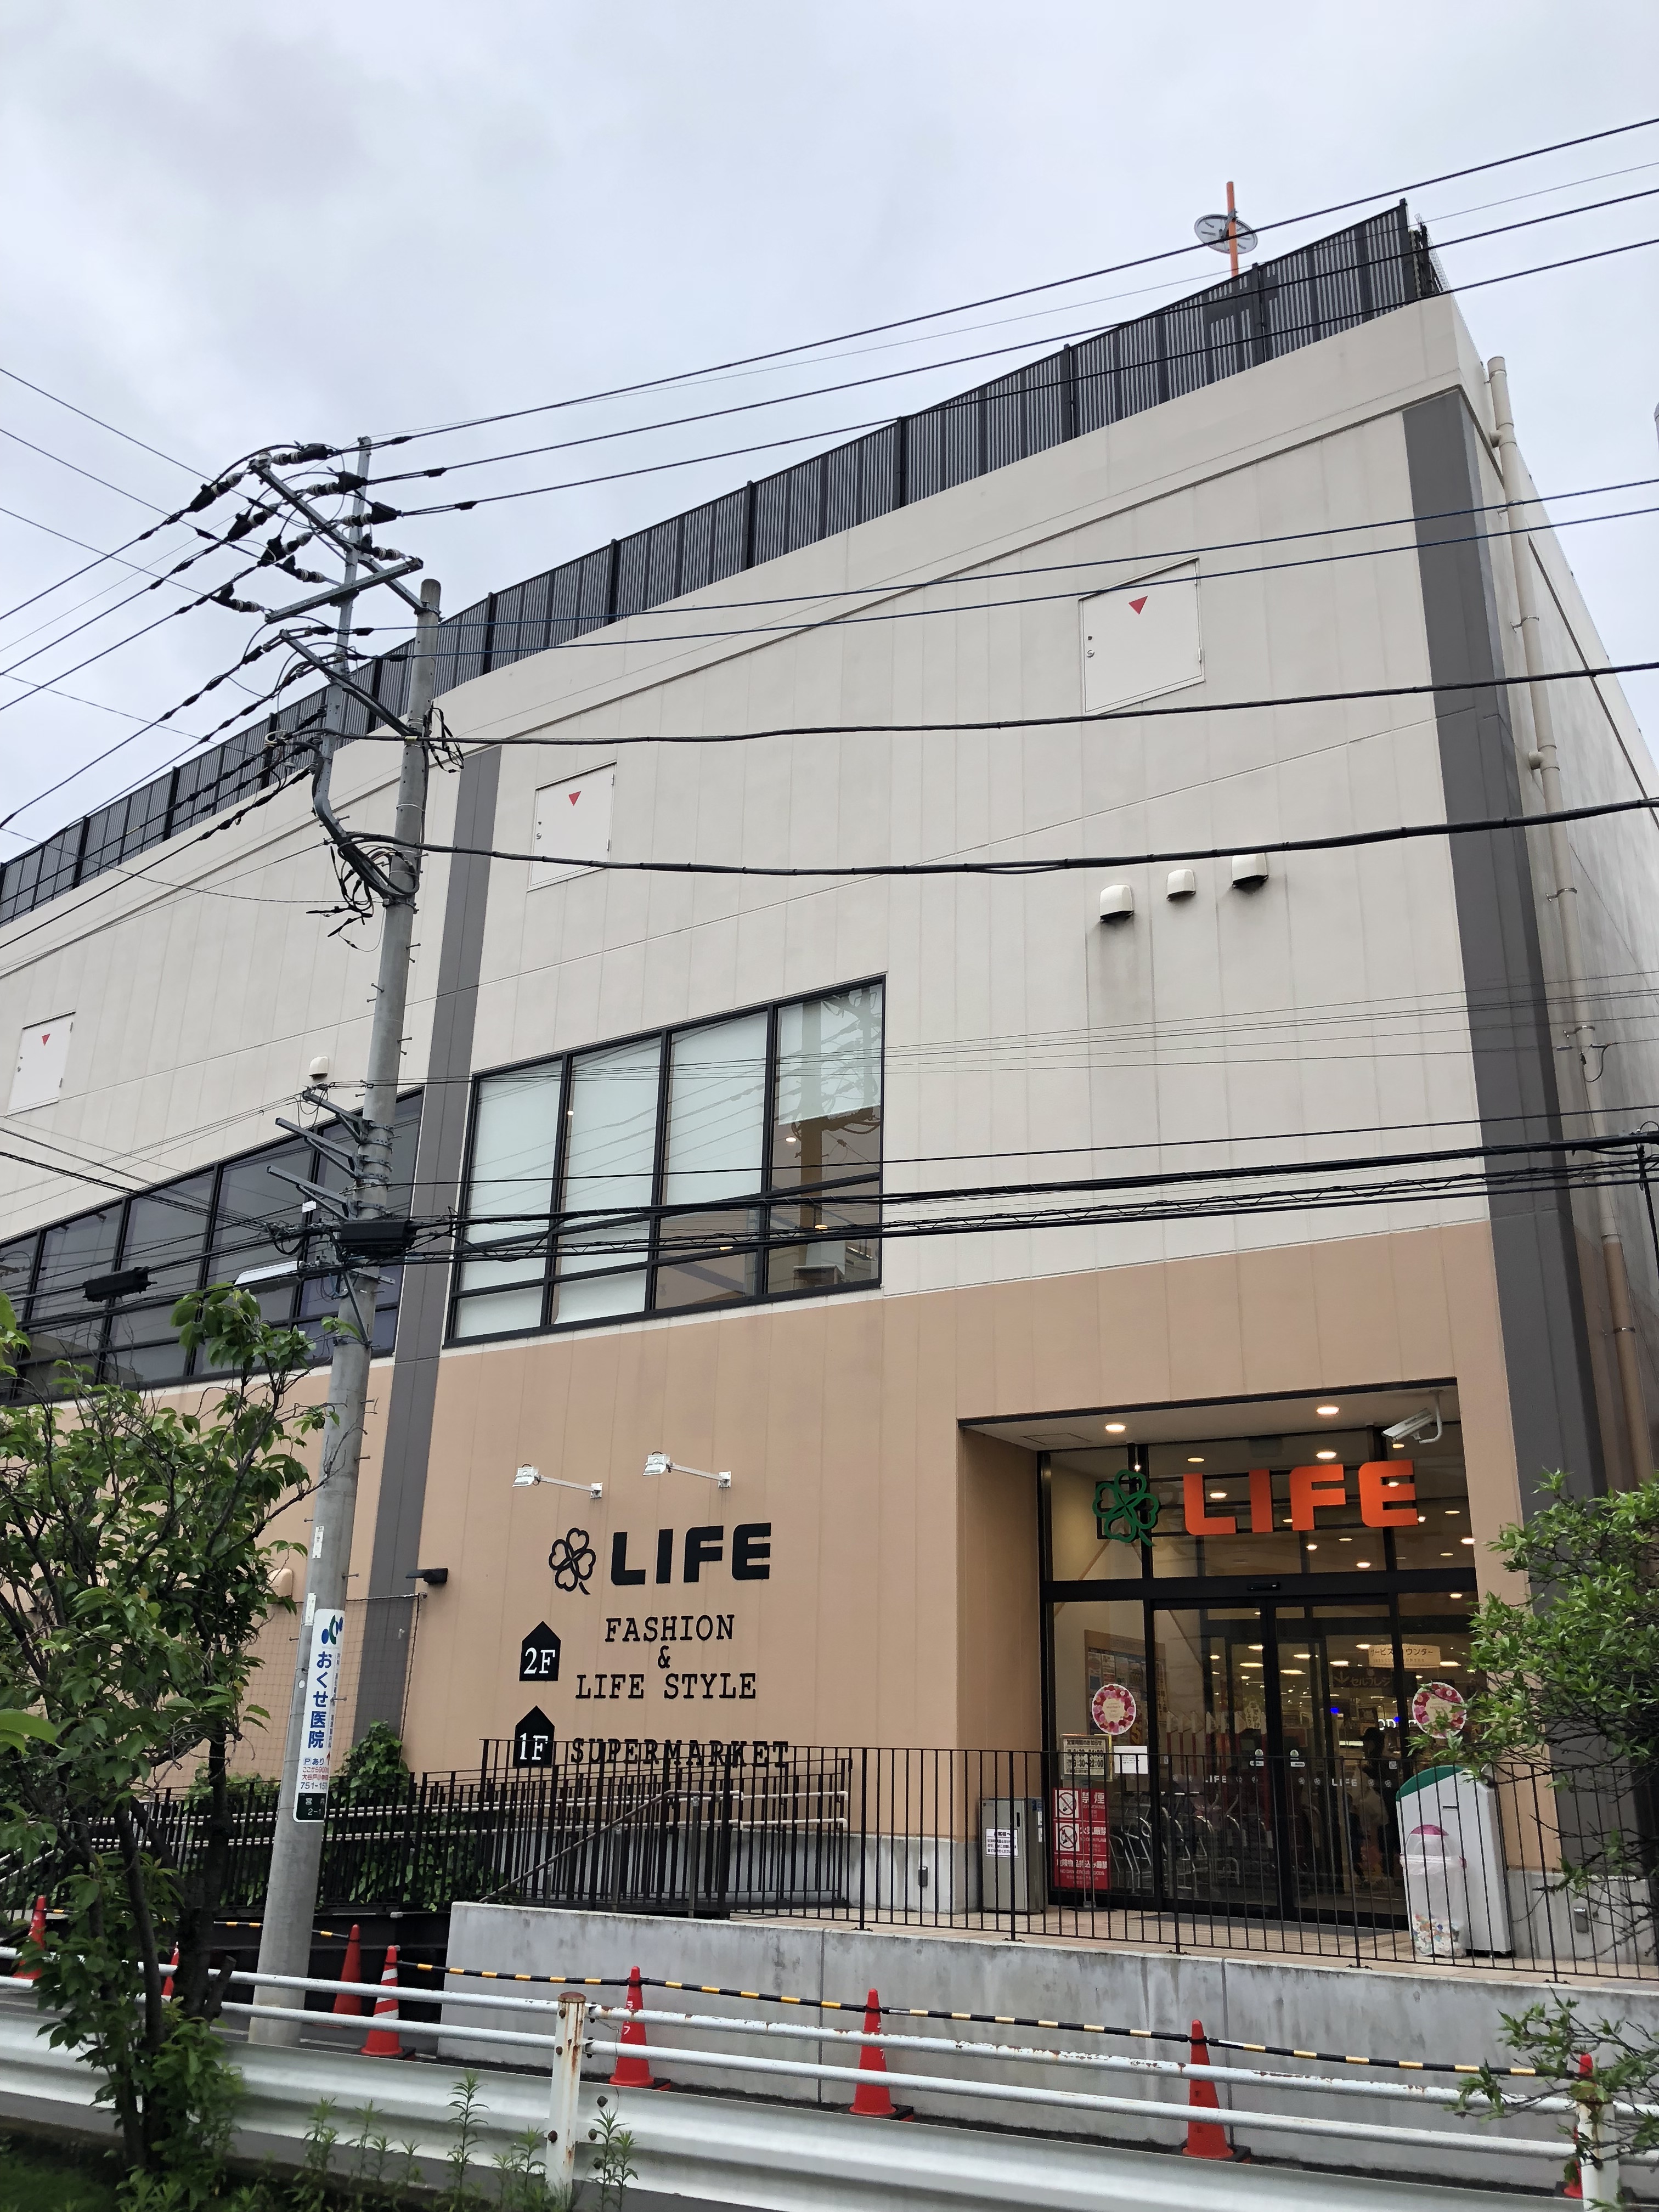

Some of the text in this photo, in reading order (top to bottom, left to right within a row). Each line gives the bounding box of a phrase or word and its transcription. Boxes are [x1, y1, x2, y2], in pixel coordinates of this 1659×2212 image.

[1183, 1459, 1419, 1536] LIFE
[611, 1522, 771, 1585] LIFE
[605, 1615, 735, 1642] FASHION
[524, 1647, 556, 1674] 2F
[658, 1645, 670, 1668] &
[308, 1651, 332, 1748] おくせ医院
[575, 1673, 756, 1700] LIFE STYLE
[519, 1735, 548, 1760] 1F
[571, 1737, 788, 1768] SUPERMARKET
[624, 2001, 634, 2035] ラフ
